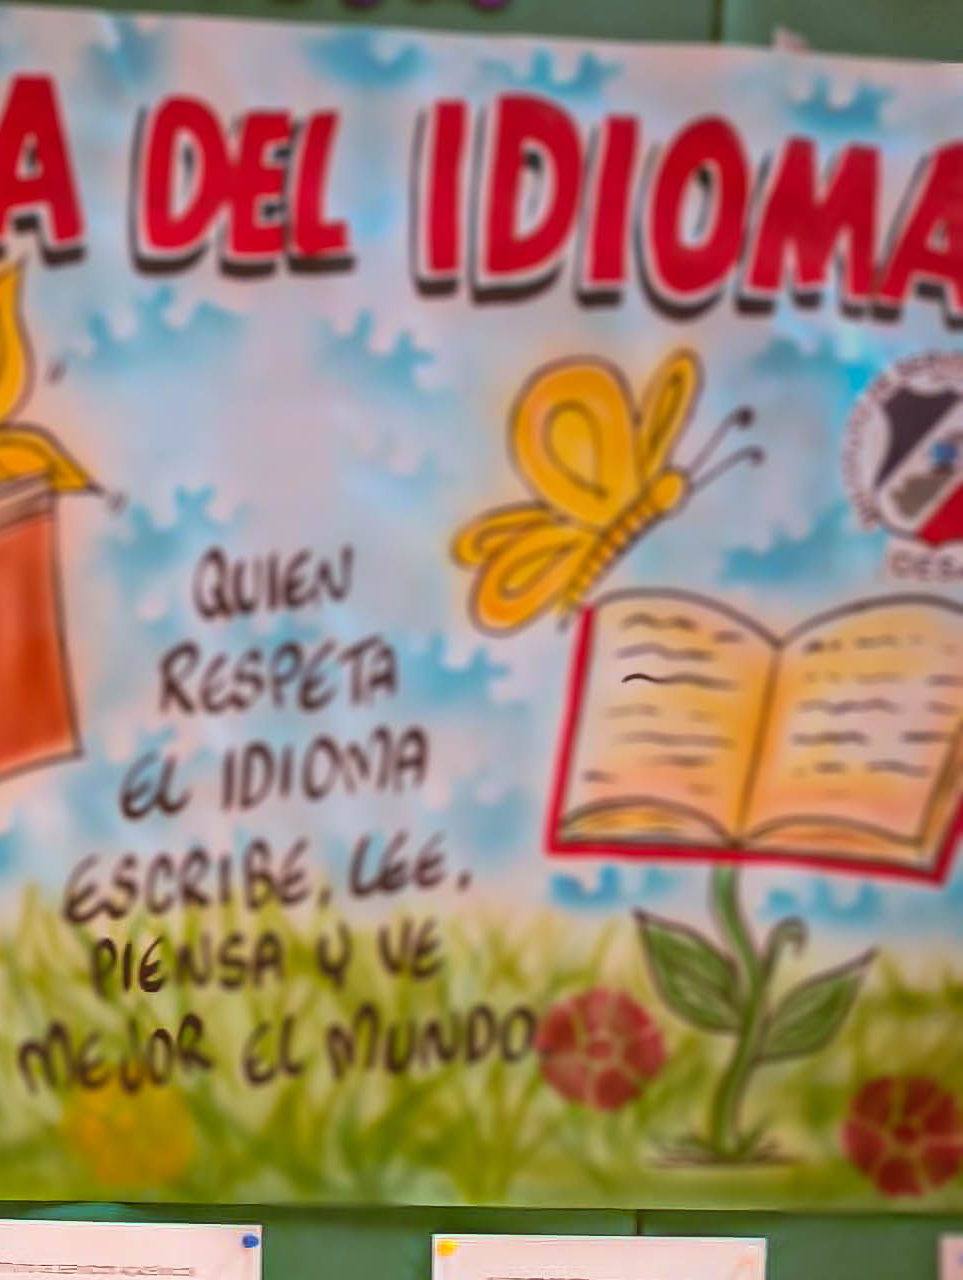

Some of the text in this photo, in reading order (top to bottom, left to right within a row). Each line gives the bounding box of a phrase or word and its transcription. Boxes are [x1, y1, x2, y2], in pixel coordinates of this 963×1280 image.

[129, 95, 354, 279] DEL
[410, 92, 963, 330] IDIOMA
[191, 545, 355, 622] QUIEN
[158, 634, 399, 715] RESPETA
[119, 725, 430, 820] EL IDIOMA
[90, 931, 285, 1000] PIENSA
[378, 917, 445, 981] VE
[16, 1002, 537, 1095] MEJOR EL MUNDO
